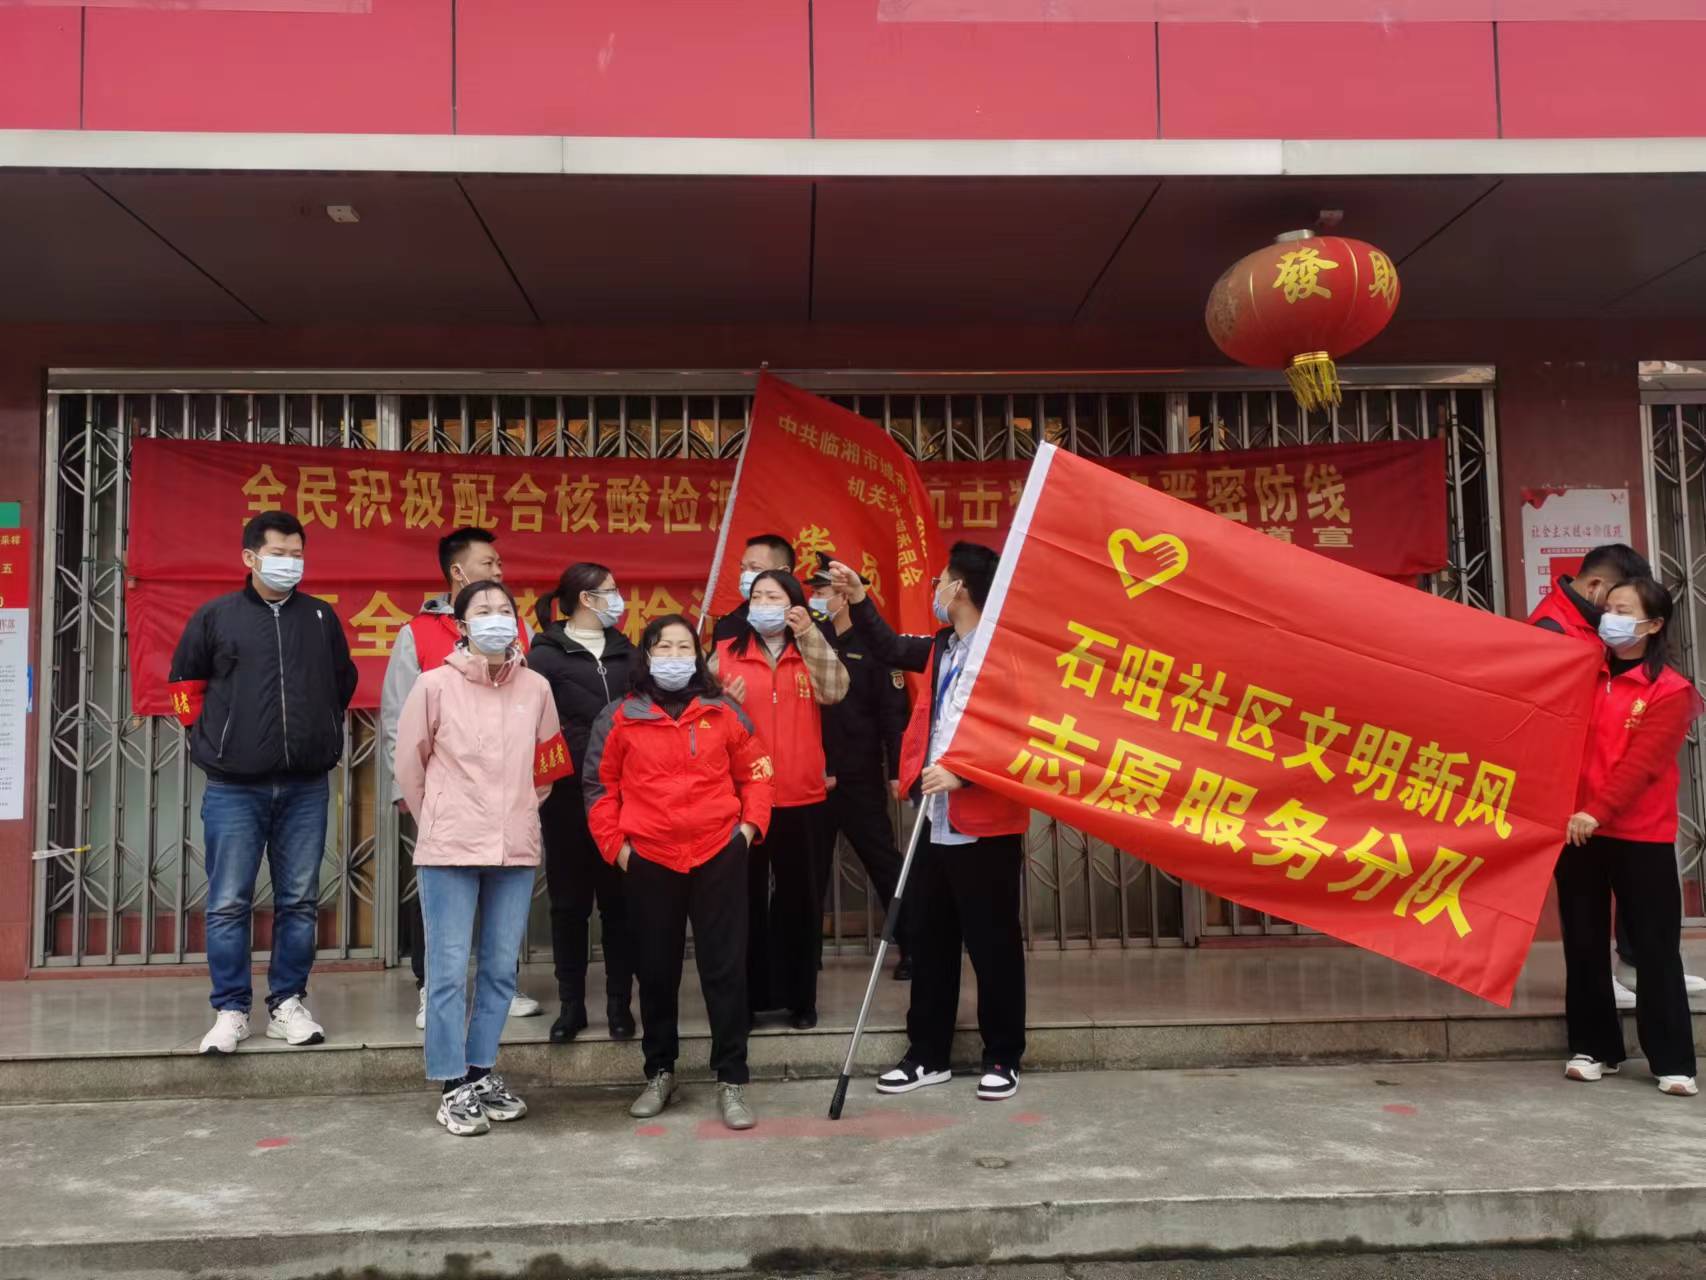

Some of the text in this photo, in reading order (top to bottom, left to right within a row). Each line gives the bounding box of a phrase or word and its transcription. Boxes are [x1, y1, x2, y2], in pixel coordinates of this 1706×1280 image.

[1272, 247, 1339, 304] 發
[1127, 463, 1352, 523] 严密防线
[1056, 620, 1517, 840] 石咀社区文明新风
[1007, 714, 1484, 938] 志愿服务分队
